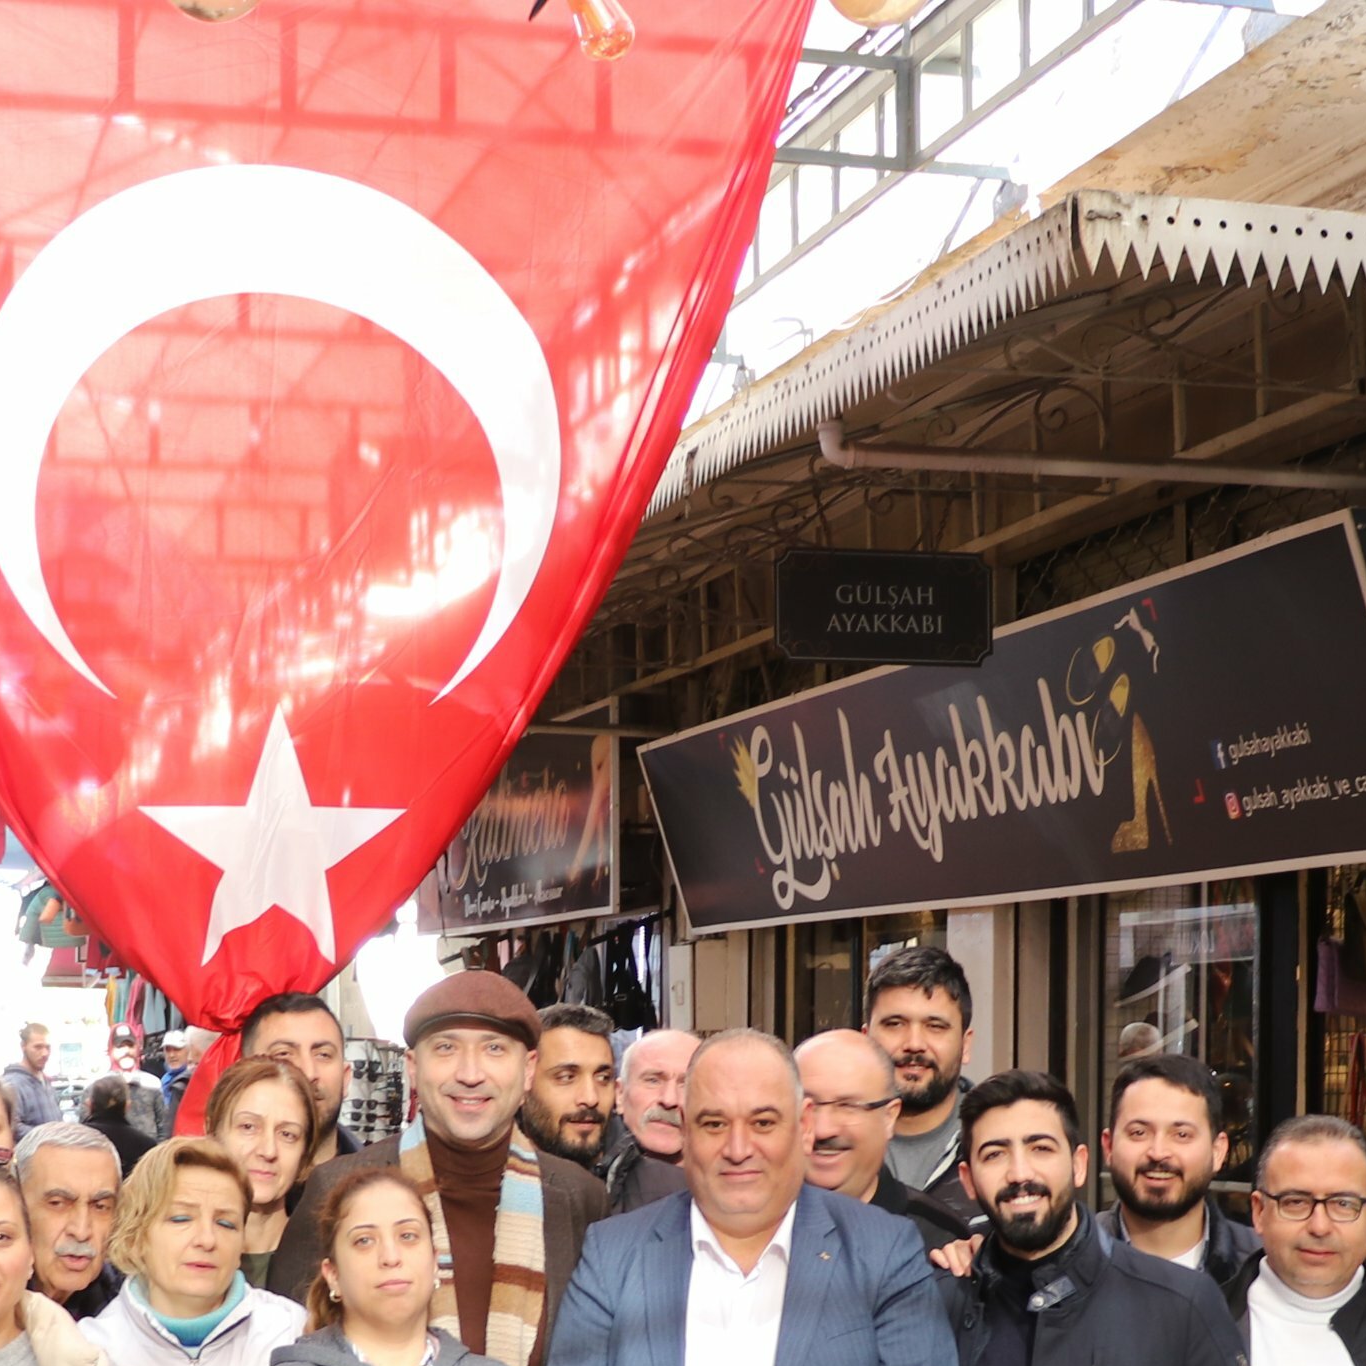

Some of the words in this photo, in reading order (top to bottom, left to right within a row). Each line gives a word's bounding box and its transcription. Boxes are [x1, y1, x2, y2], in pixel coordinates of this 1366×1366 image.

[835, 581, 934, 610] GÜLŞAH
[826, 613, 943, 634] AYAKKABI
[1228, 722, 1312, 765] gulsahayakkabi
[750, 707, 882, 911] Gülşah
